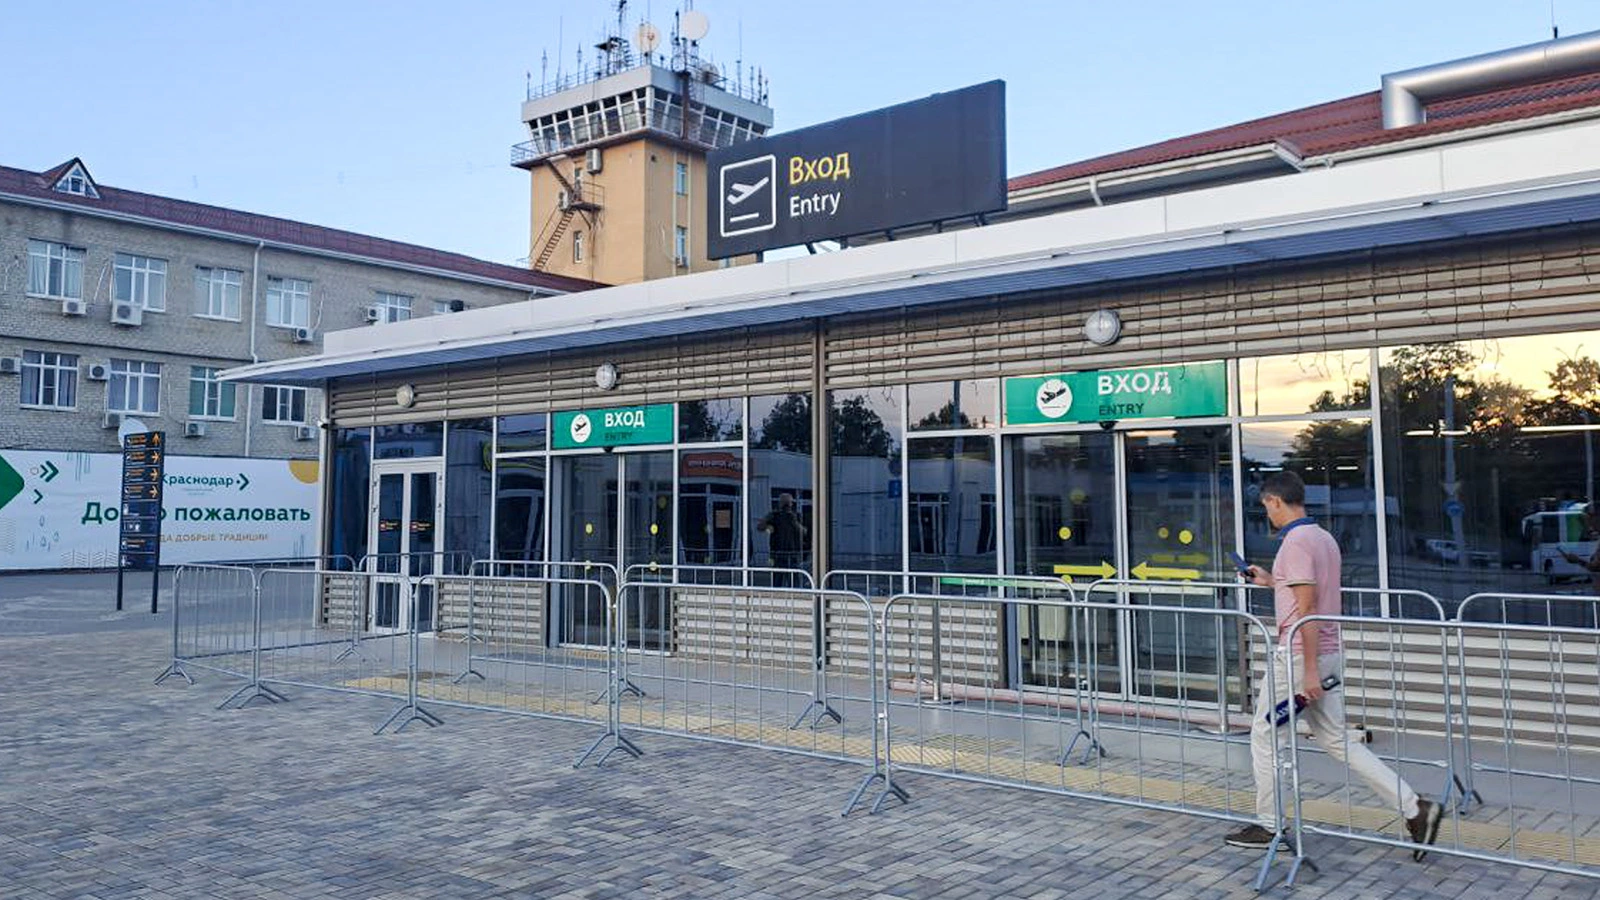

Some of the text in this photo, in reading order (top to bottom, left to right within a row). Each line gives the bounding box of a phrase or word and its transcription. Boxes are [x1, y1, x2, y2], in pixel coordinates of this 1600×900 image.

[789, 152, 850, 185] Вход
[790, 191, 841, 217] Entry
[1097, 371, 1172, 396] ВХОД
[1099, 403, 1145, 416] ENTRY
[604, 410, 645, 428] ВХОД
[604, 432, 633, 440] ENTRY
[175, 507, 311, 521] пожаловать
